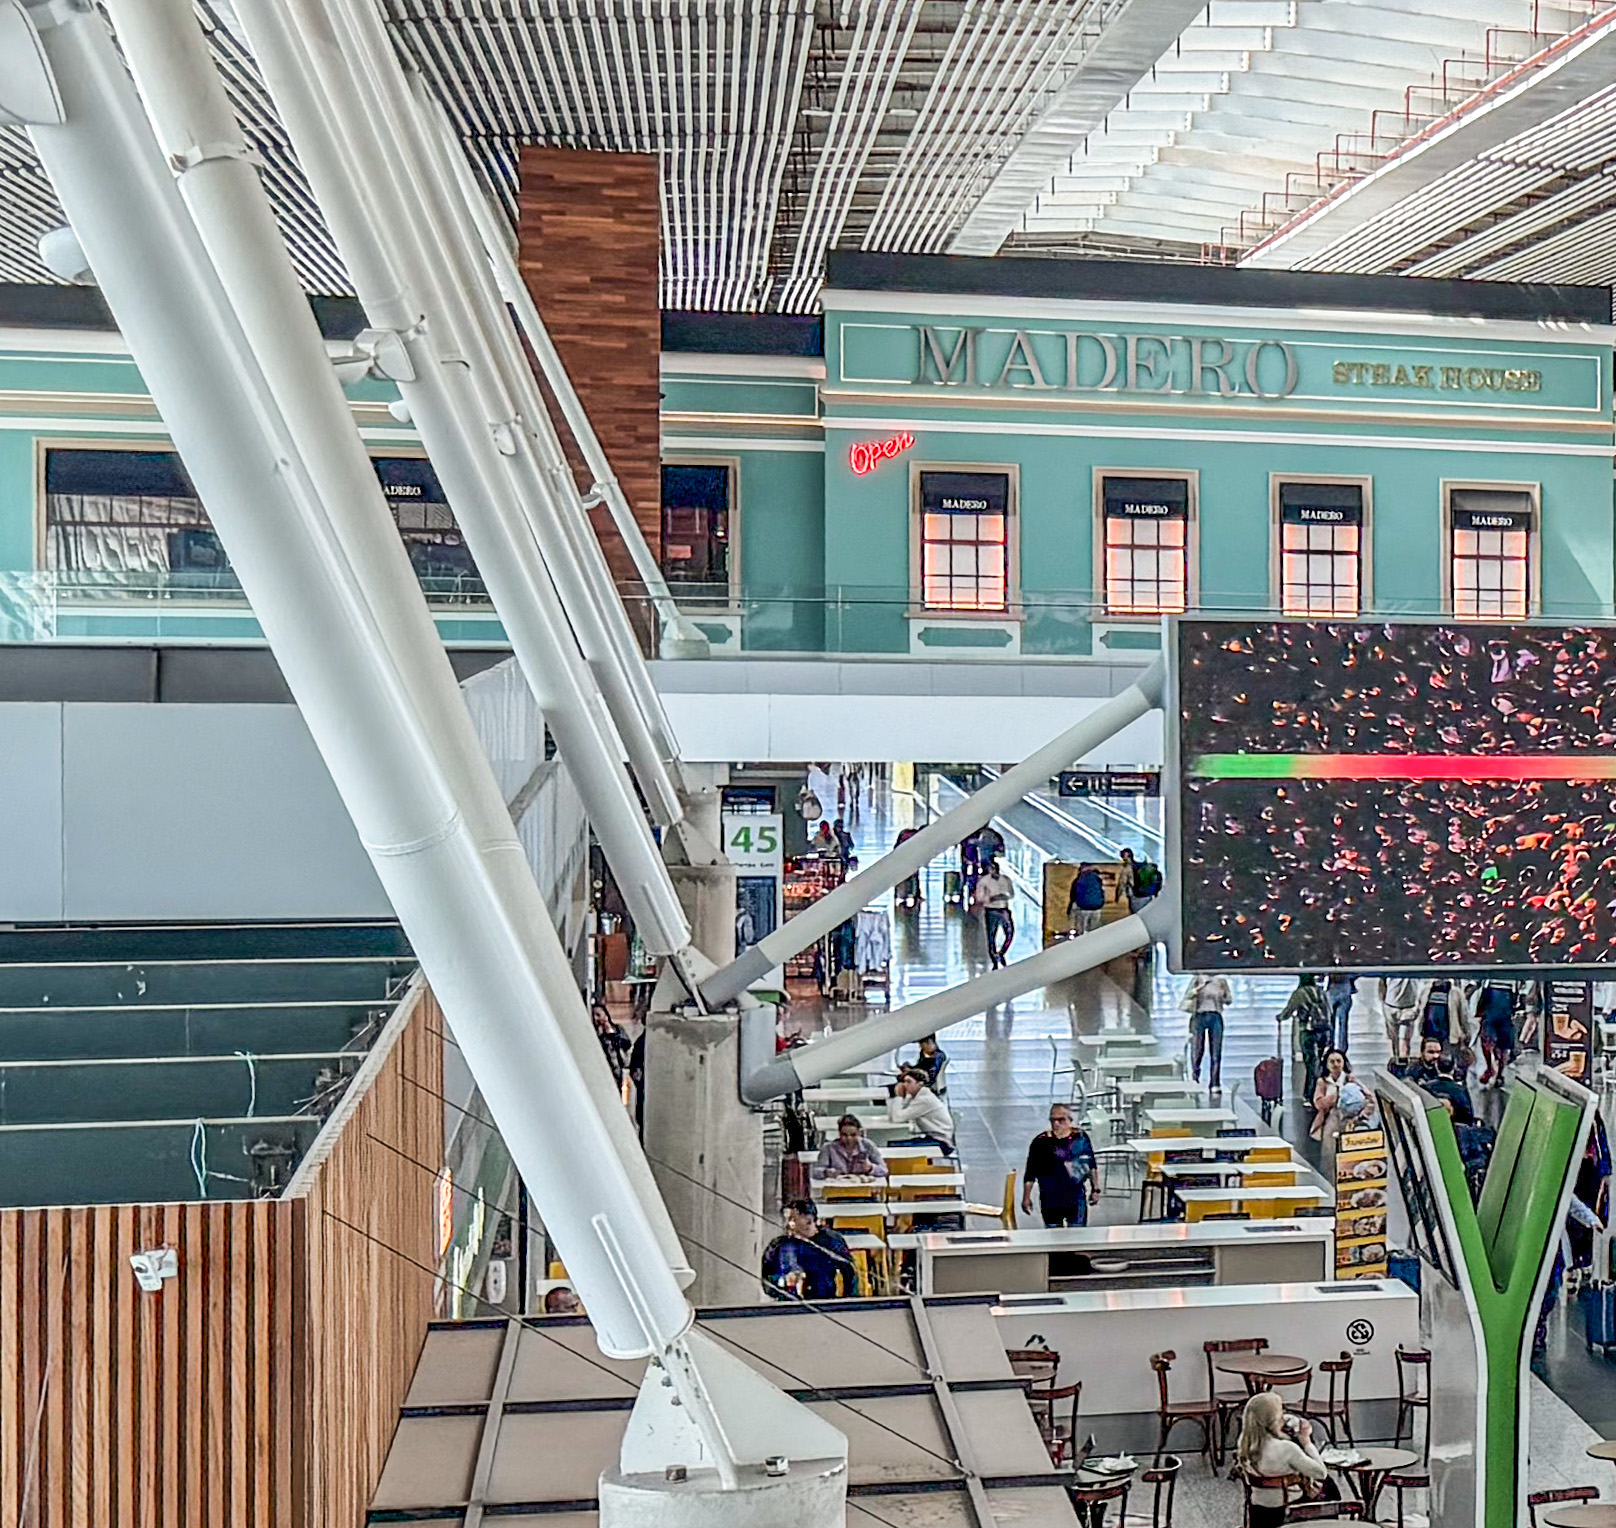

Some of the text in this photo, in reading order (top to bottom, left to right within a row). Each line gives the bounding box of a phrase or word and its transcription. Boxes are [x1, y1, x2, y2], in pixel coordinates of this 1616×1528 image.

[914, 325, 1299, 400] MADERO
[1333, 361, 1542, 392] STEAK HOUSE
[849, 431, 915, 476] Open
[942, 499, 987, 510] MADERO
[1125, 504, 1168, 515] MADERO
[1301, 509, 1343, 521] MADERO
[1471, 515, 1513, 526] MADERO
[731, 826, 777, 854] 45
